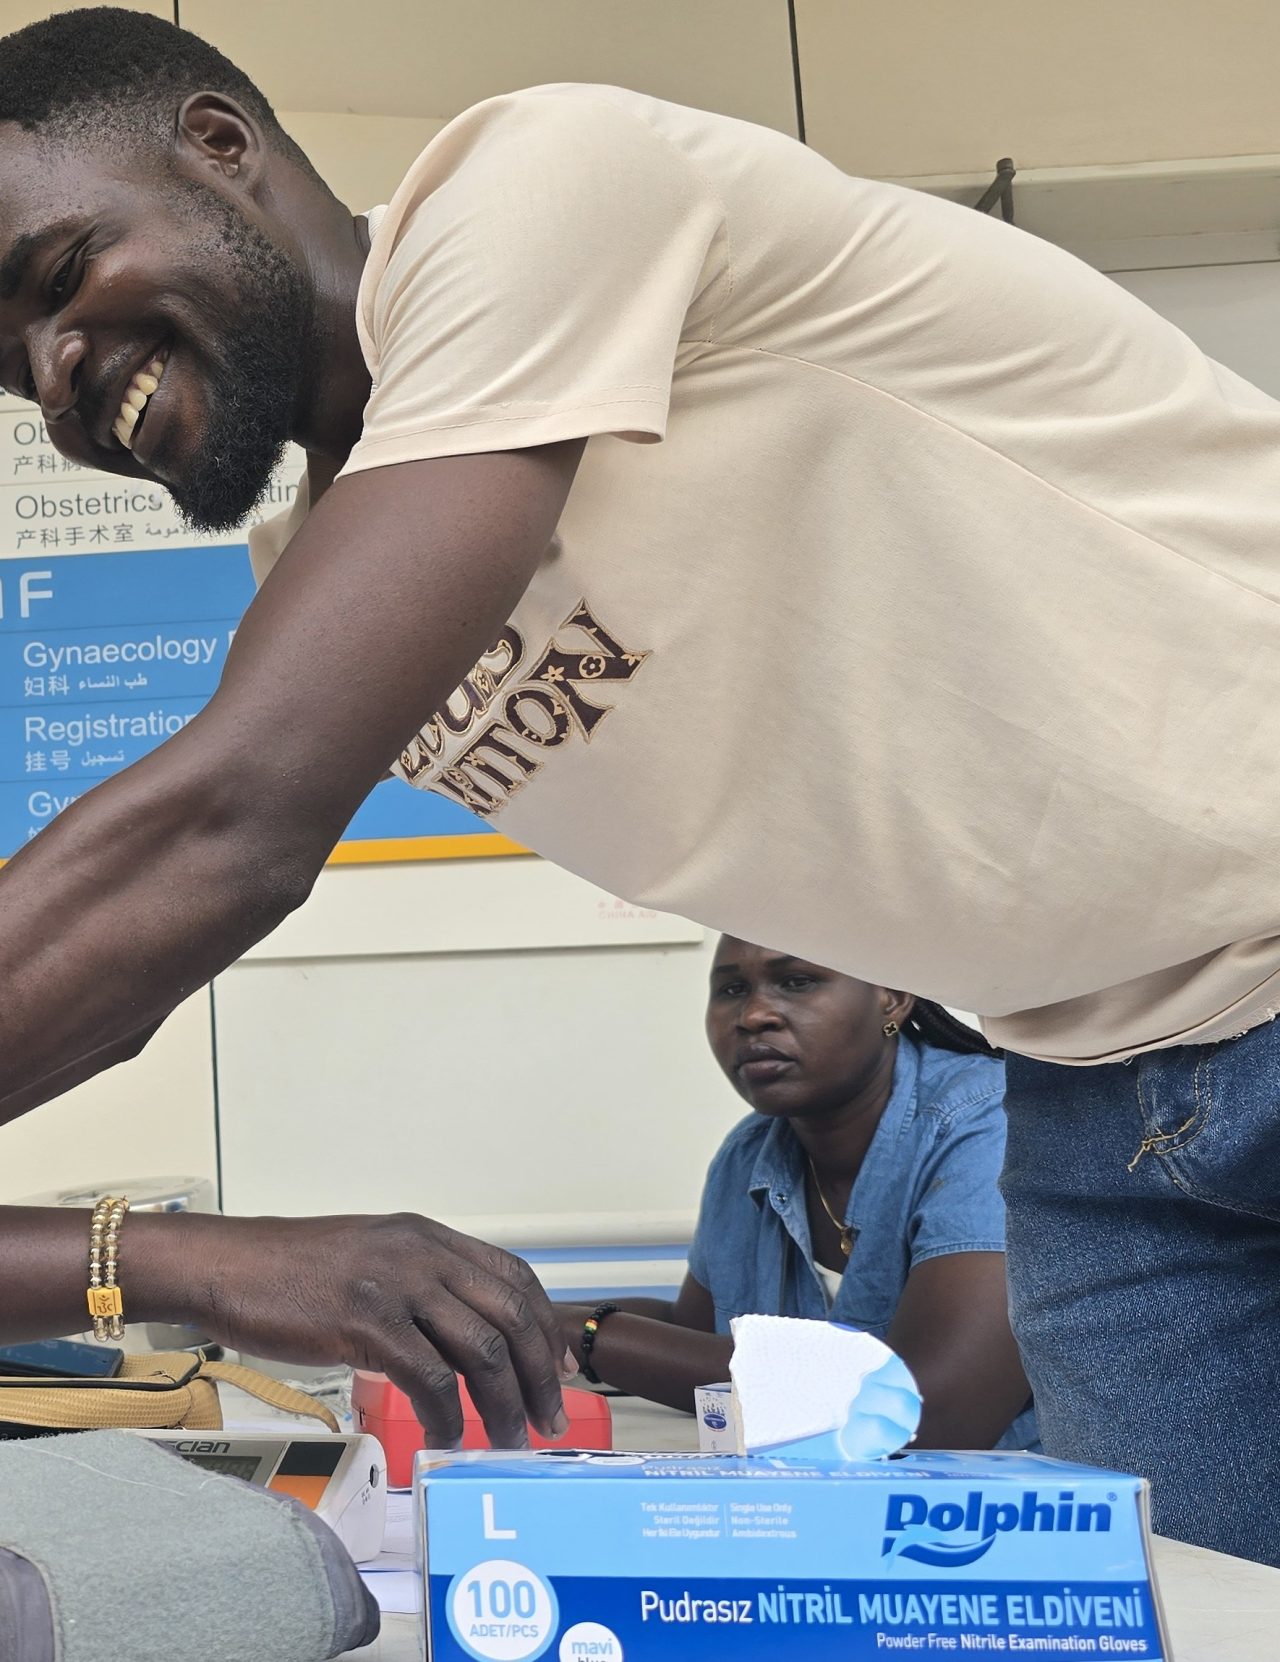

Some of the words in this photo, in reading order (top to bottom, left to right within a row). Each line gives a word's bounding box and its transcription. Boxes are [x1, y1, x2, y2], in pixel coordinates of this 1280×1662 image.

[15, 489, 163, 520] Obstetrics
[16, 523, 134, 549] 产科手术室
[23, 634, 217, 673] Gynaecology
[24, 674, 70, 697] 妇科
[25, 750, 71, 773] 挂号
[482, 1493, 517, 1540] L
[885, 1491, 1112, 1541] Dolphin
[467, 1579, 537, 1619] 100
[641, 1590, 754, 1624] Pudrasız
[758, 1585, 852, 1625] NİTRİL
[859, 1592, 1000, 1626] MUAYENE
[1007, 1587, 1145, 1628] ELDİVENİ
[469, 1624, 539, 1639] ADET/PCS
[876, 1632, 925, 1649] Powder
[928, 1633, 957, 1649] Free
[960, 1633, 1006, 1650] Nitrile
[1009, 1634, 1096, 1651] Examination
[1099, 1635, 1147, 1652] Gloves
[572, 1637, 613, 1655] mavi
